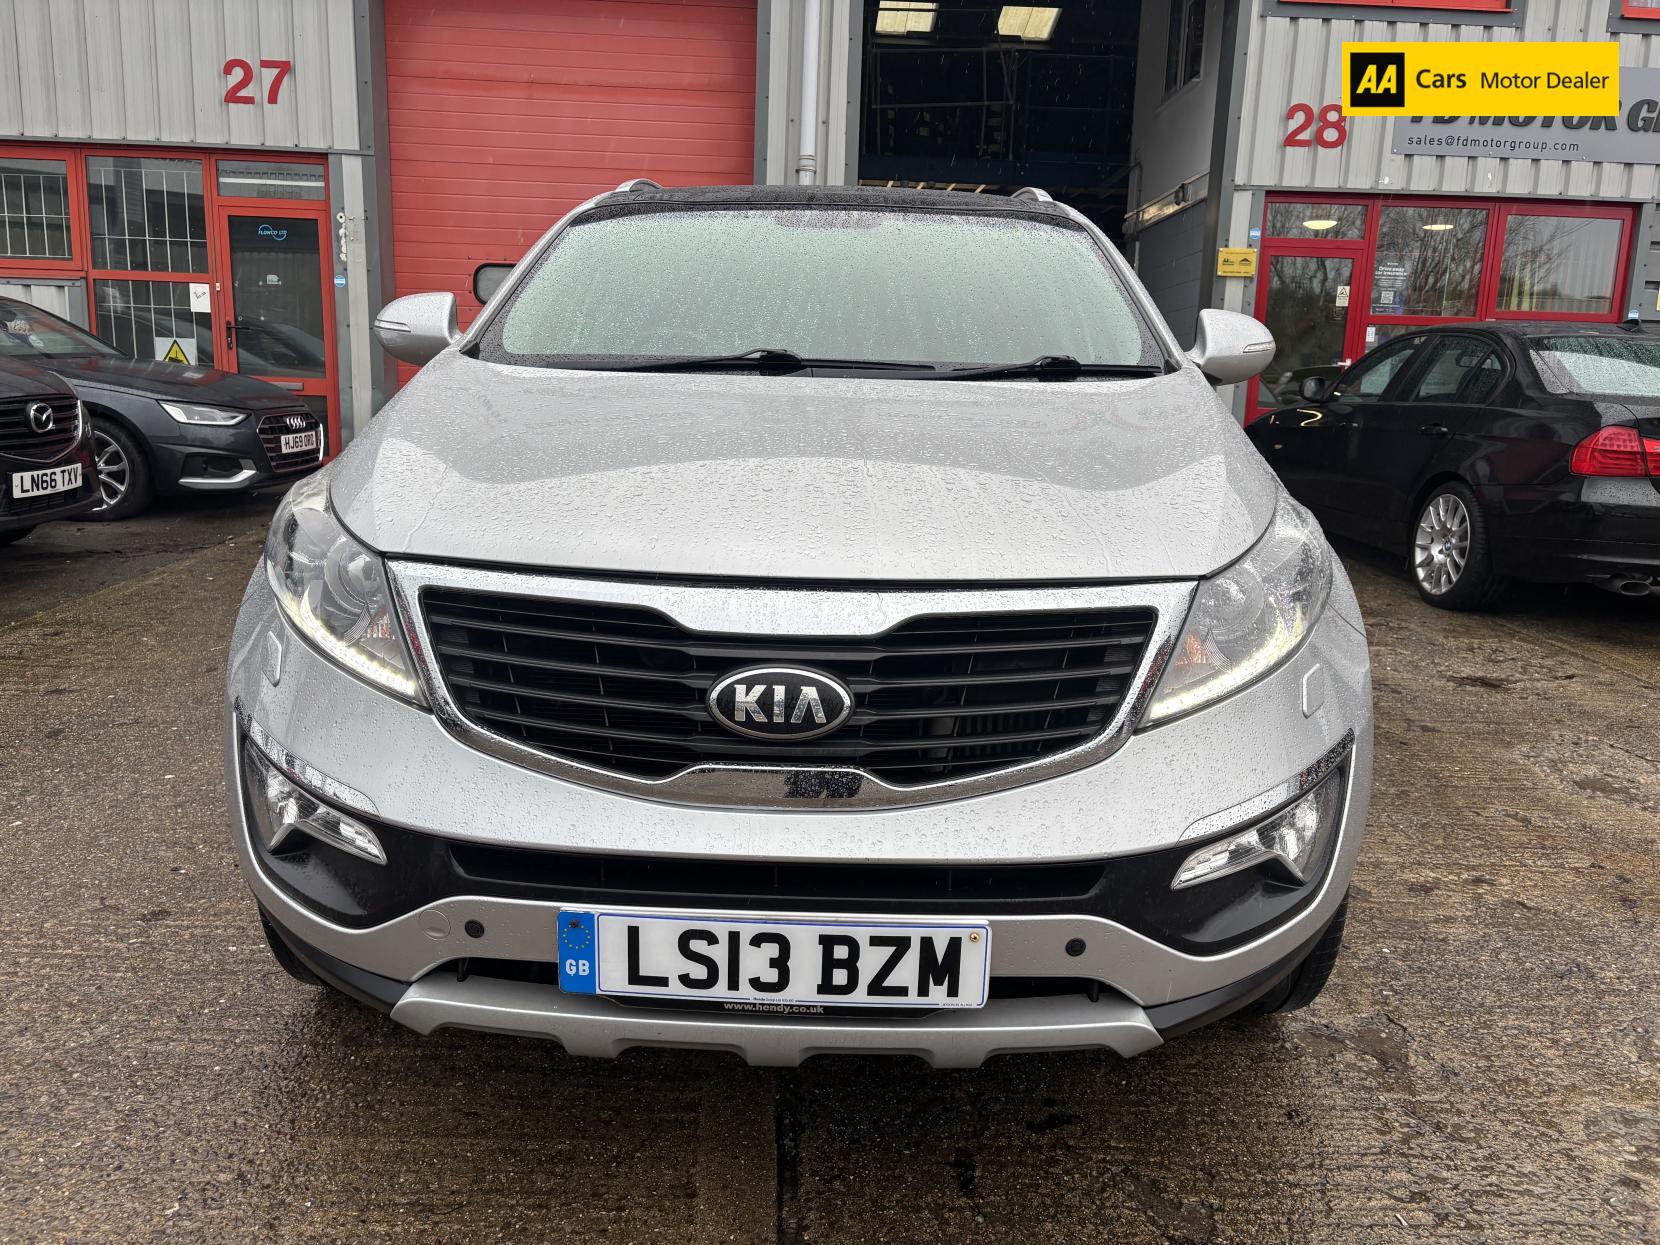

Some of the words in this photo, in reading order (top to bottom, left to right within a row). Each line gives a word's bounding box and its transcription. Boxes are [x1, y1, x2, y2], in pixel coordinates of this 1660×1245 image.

[223, 58, 292, 104] 27
[1283, 103, 1347, 149] 28
[1407, 134, 1580, 152] sales@fdmotorgroup.com
[285, 436, 303, 450] HJ69
[20, 472, 57, 494] LN66
[60, 466, 79, 487] TXV
[734, 684, 826, 724] KIA
[565, 958, 590, 977] GB
[626, 925, 791, 994] LS13
[816, 933, 963, 998] BZM
[723, 1002, 824, 1014] www.hendy.co.uk
